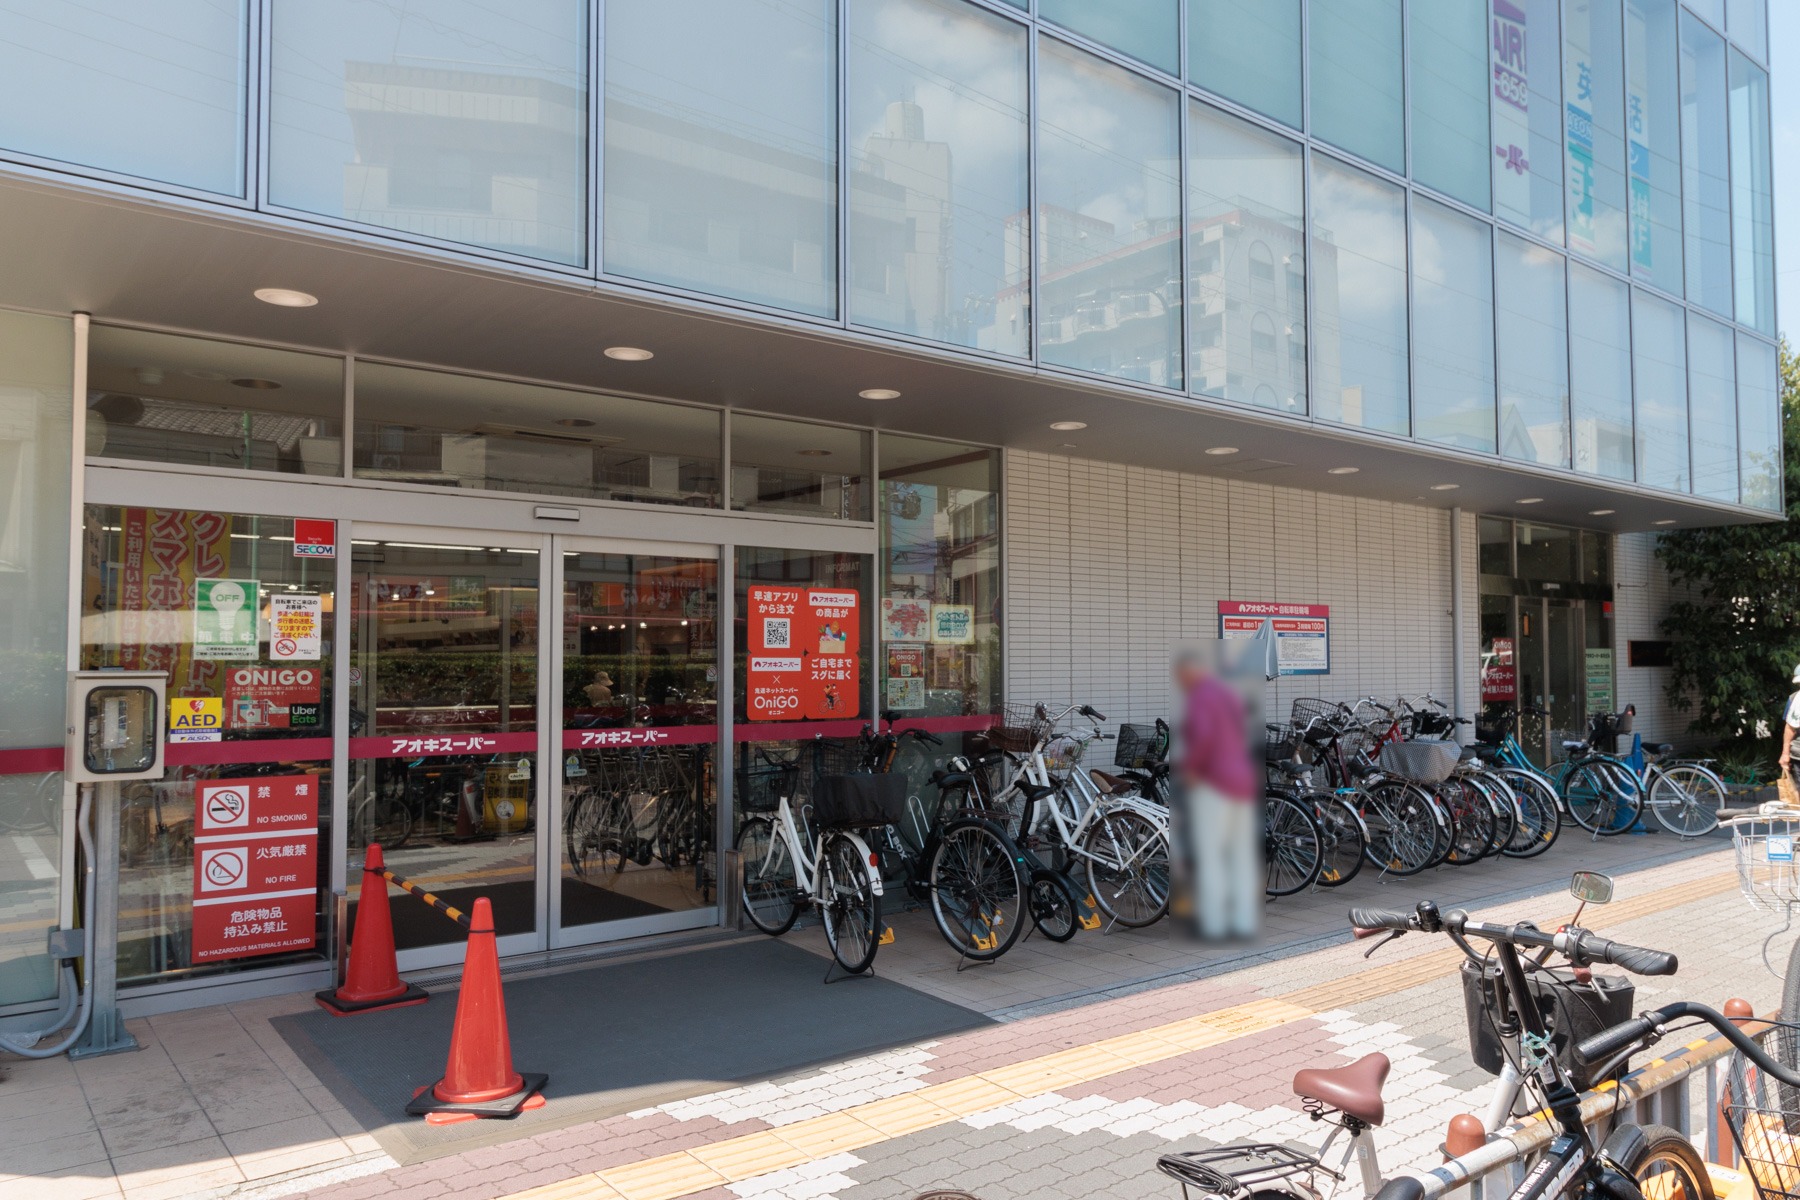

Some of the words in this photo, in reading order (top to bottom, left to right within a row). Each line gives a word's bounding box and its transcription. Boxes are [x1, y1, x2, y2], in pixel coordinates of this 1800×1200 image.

[296, 545, 333, 554] SECOM
[122, 521, 144, 663] ご利用いただけます
[215, 594, 240, 602] OFF
[818, 596, 853, 604] アオキスーパー
[758, 604, 795, 615] から注文
[816, 608, 848, 618] の商品が
[1246, 604, 1279, 613] アオキスーパー
[811, 658, 852, 668] ご自宅まで
[234, 669, 313, 686] ONIGO
[811, 670, 851, 680] スグに届く
[754, 695, 798, 709] OniGO
[292, 706, 317, 715] Uber
[176, 714, 217, 727] AED
[292, 715, 317, 724] Eats
[581, 730, 668, 745] アオキスーパー
[392, 736, 496, 754] アオキスーパー
[256, 816, 270, 824] NO
[271, 813, 308, 823] SMOKING
[256, 844, 307, 860] 火気厳禁
[265, 876, 278, 884] NO
[279, 874, 297, 882] FIRE
[230, 906, 283, 924] 危険物品
[223, 919, 288, 939] 持込み禁止
[209, 945, 247, 956] HAZARDOUS
[247, 941, 281, 951] MATERIALS
[282, 937, 311, 947] ALLOWED
